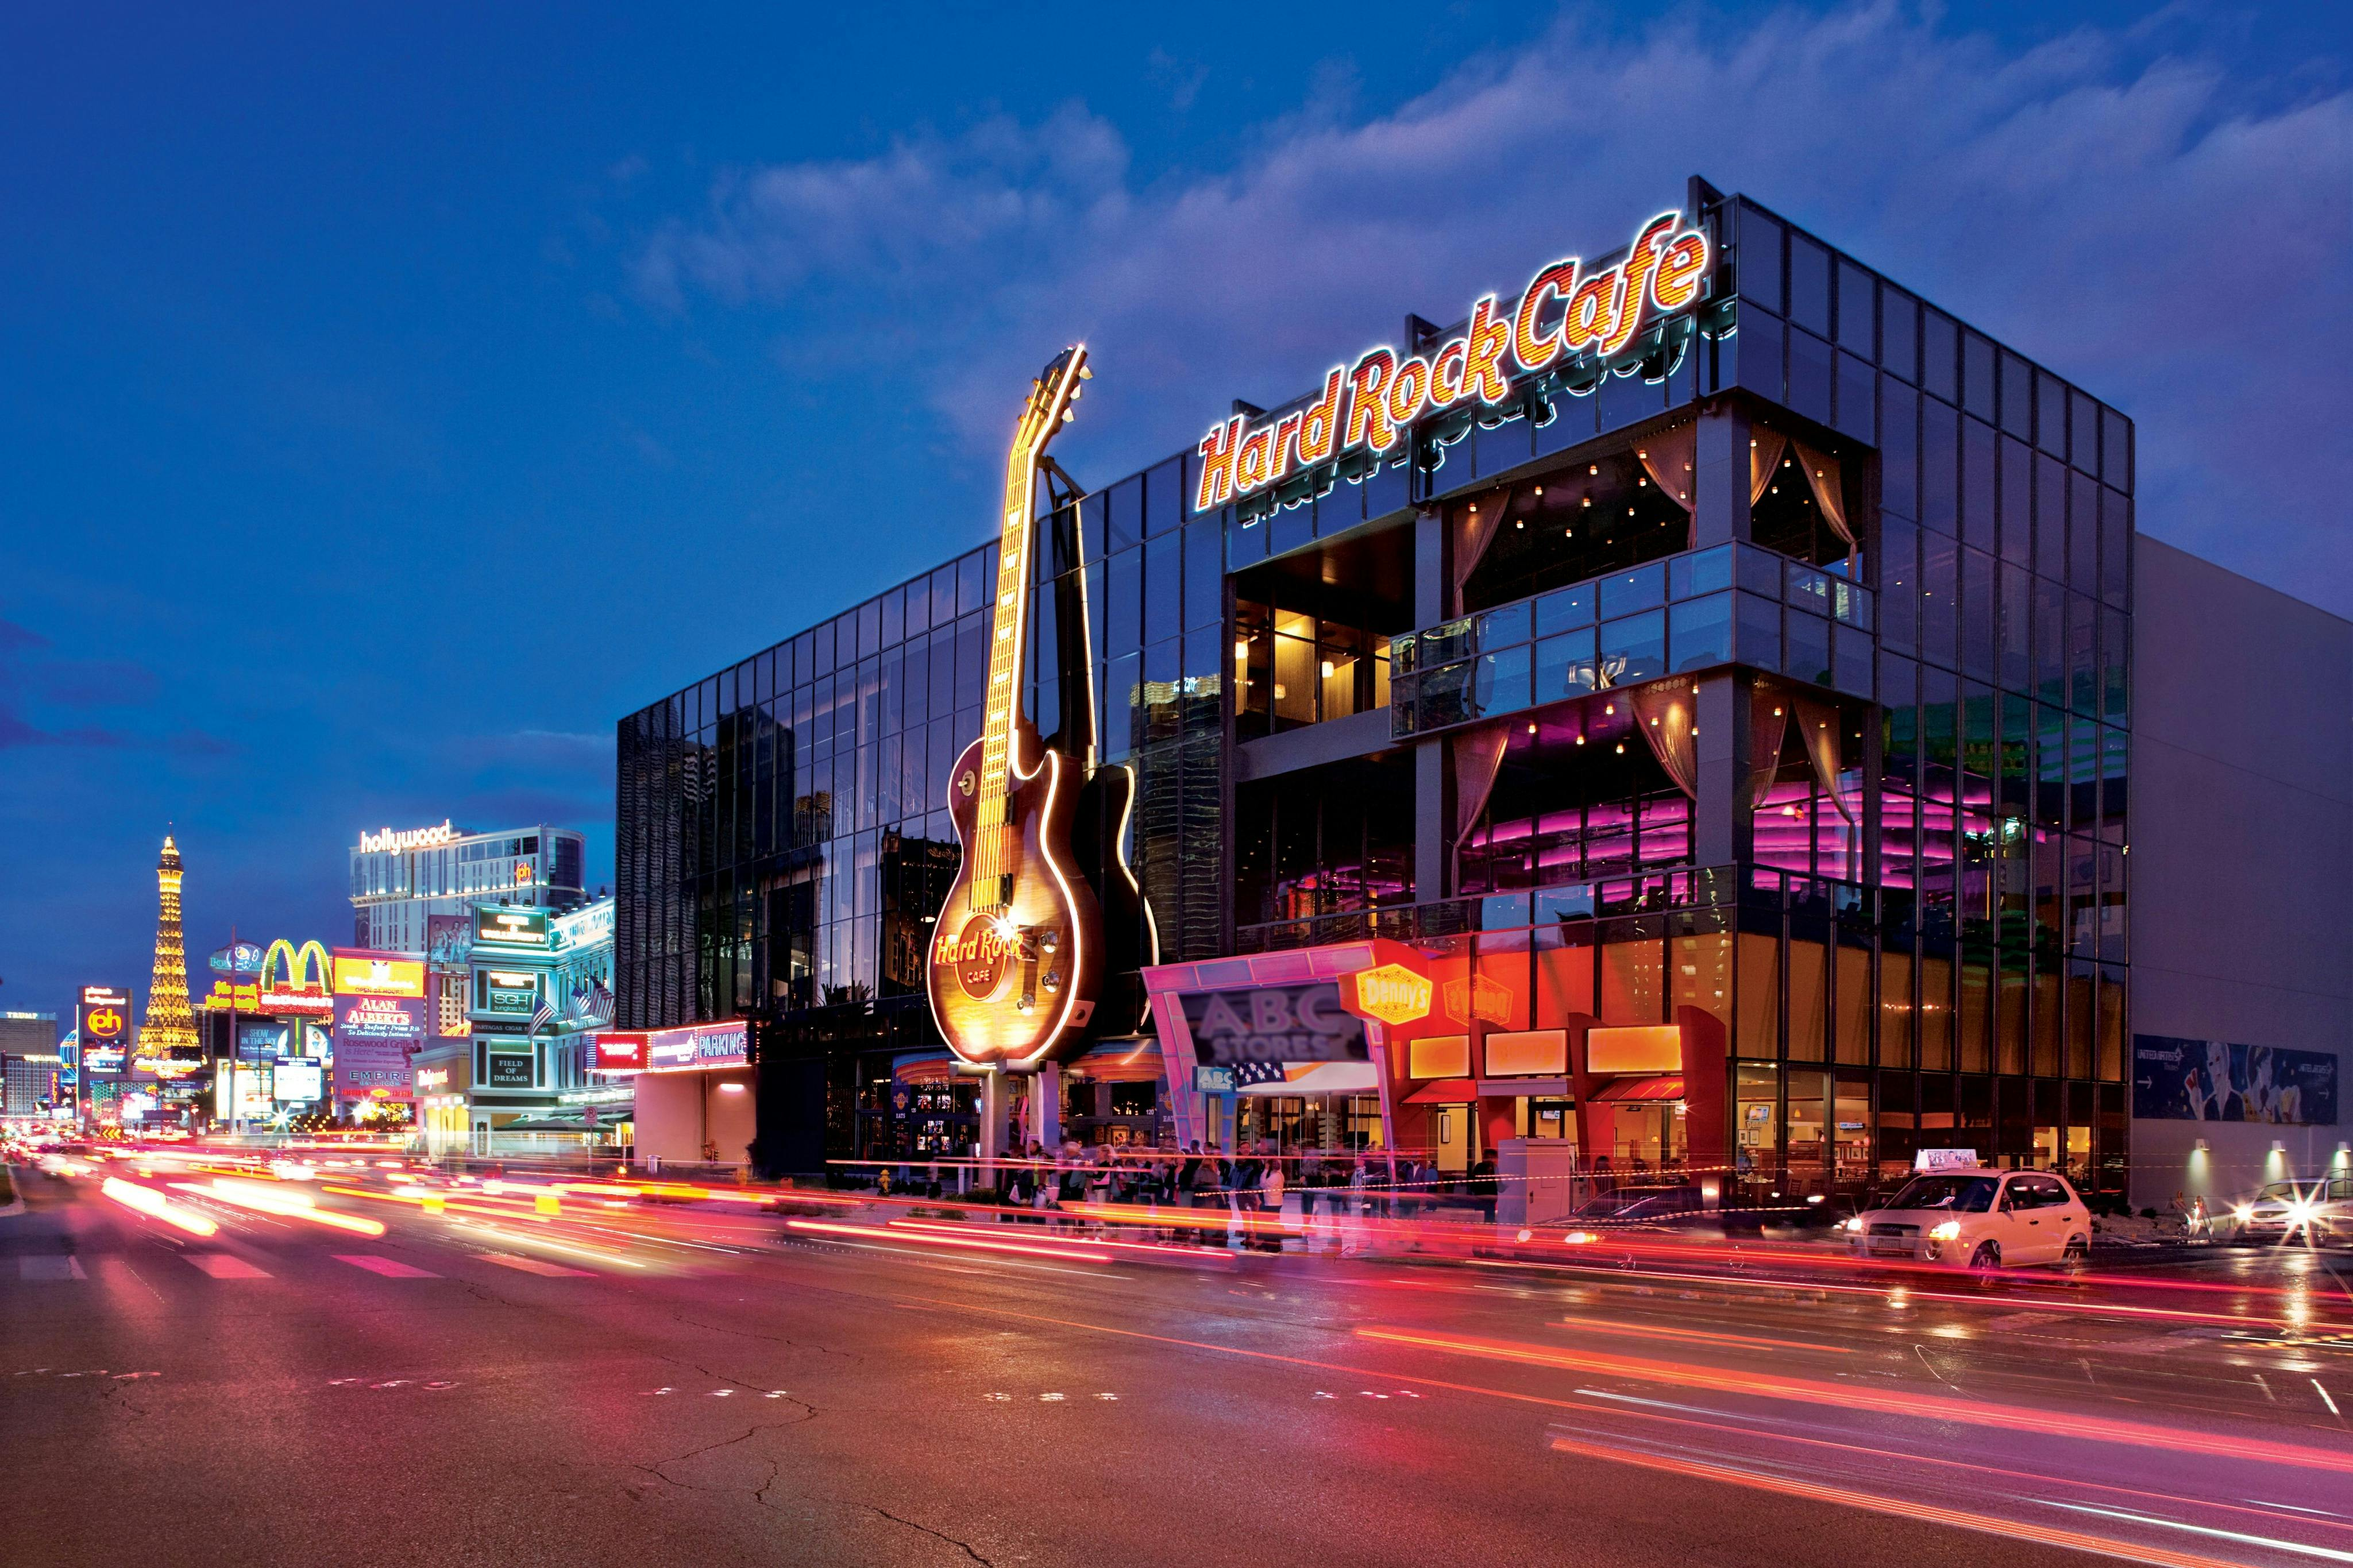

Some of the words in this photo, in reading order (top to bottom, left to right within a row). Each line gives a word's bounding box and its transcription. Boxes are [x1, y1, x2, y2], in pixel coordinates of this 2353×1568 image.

[1195, 365, 1345, 512] Hard
[1344, 293, 1512, 453] Rock
[1512, 210, 1709, 371] Cafe
[360, 818, 450, 856] hollywood
[935, 929, 979, 964] Hard
[979, 925, 1024, 965] Rock
[967, 969, 992, 983] CAFE
[495, 994, 528, 1005] SGH
[1365, 978, 1428, 1010] Denny's
[359, 998, 398, 1011] ALAN
[6, 1011, 38, 1019] TRUMP
[1197, 985, 1340, 1039] ABC
[249, 1029, 269, 1038] SHOW
[356, 1029, 388, 1038] Deliciously
[343, 1037, 388, 1048] Rosewood
[391, 1039, 413, 1049] Grille
[699, 1032, 745, 1058] PARKING
[1212, 1034, 1330, 1062] STORES
[349, 1070, 411, 1081] EMPIRE
[1199, 1070, 1234, 1084] ABC
